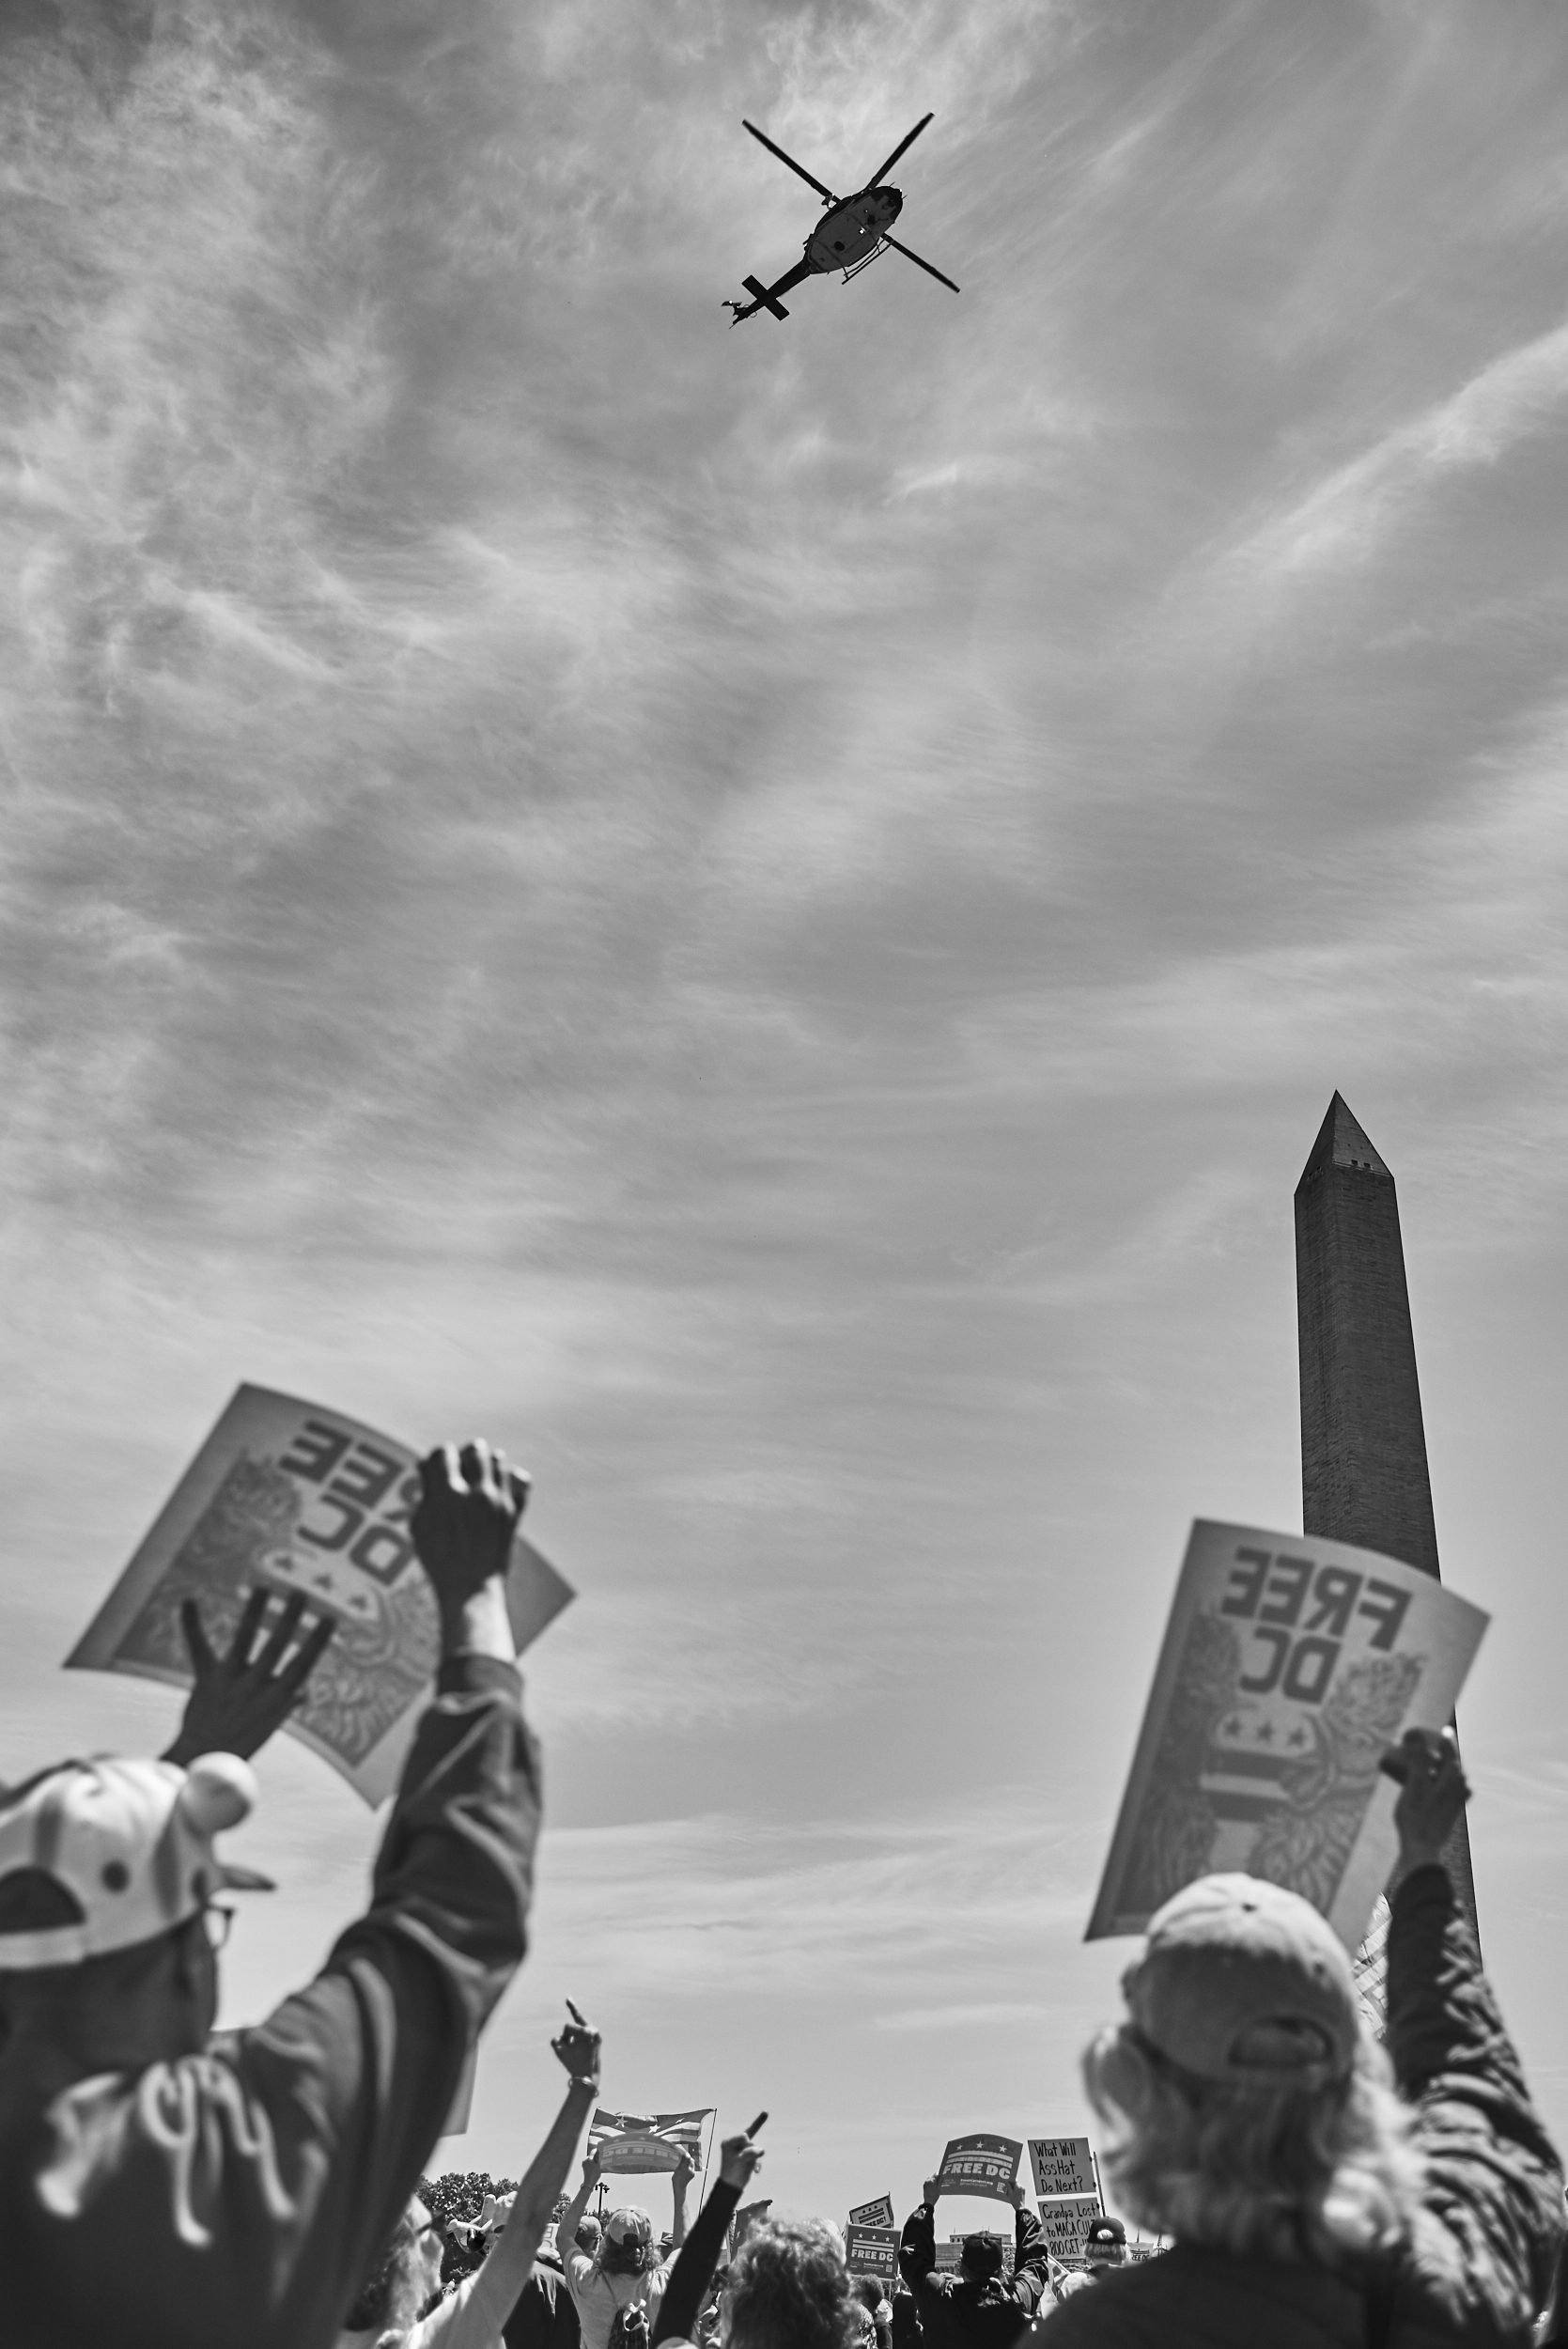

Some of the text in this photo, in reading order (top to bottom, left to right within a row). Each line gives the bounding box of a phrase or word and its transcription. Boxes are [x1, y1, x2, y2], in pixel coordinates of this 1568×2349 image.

[1034, 2142, 1058, 2157] What
[1059, 2142, 1077, 2156] Will
[942, 2162, 1011, 2180] FREE DC
[1040, 2175, 1083, 2193] Do Next?
[1042, 2201, 1095, 2221] Grandpa Lost
[1047, 2226, 1056, 2237] to
[1055, 2220, 1078, 2236] MAGA
[851, 2248, 893, 2263] FREE DC
